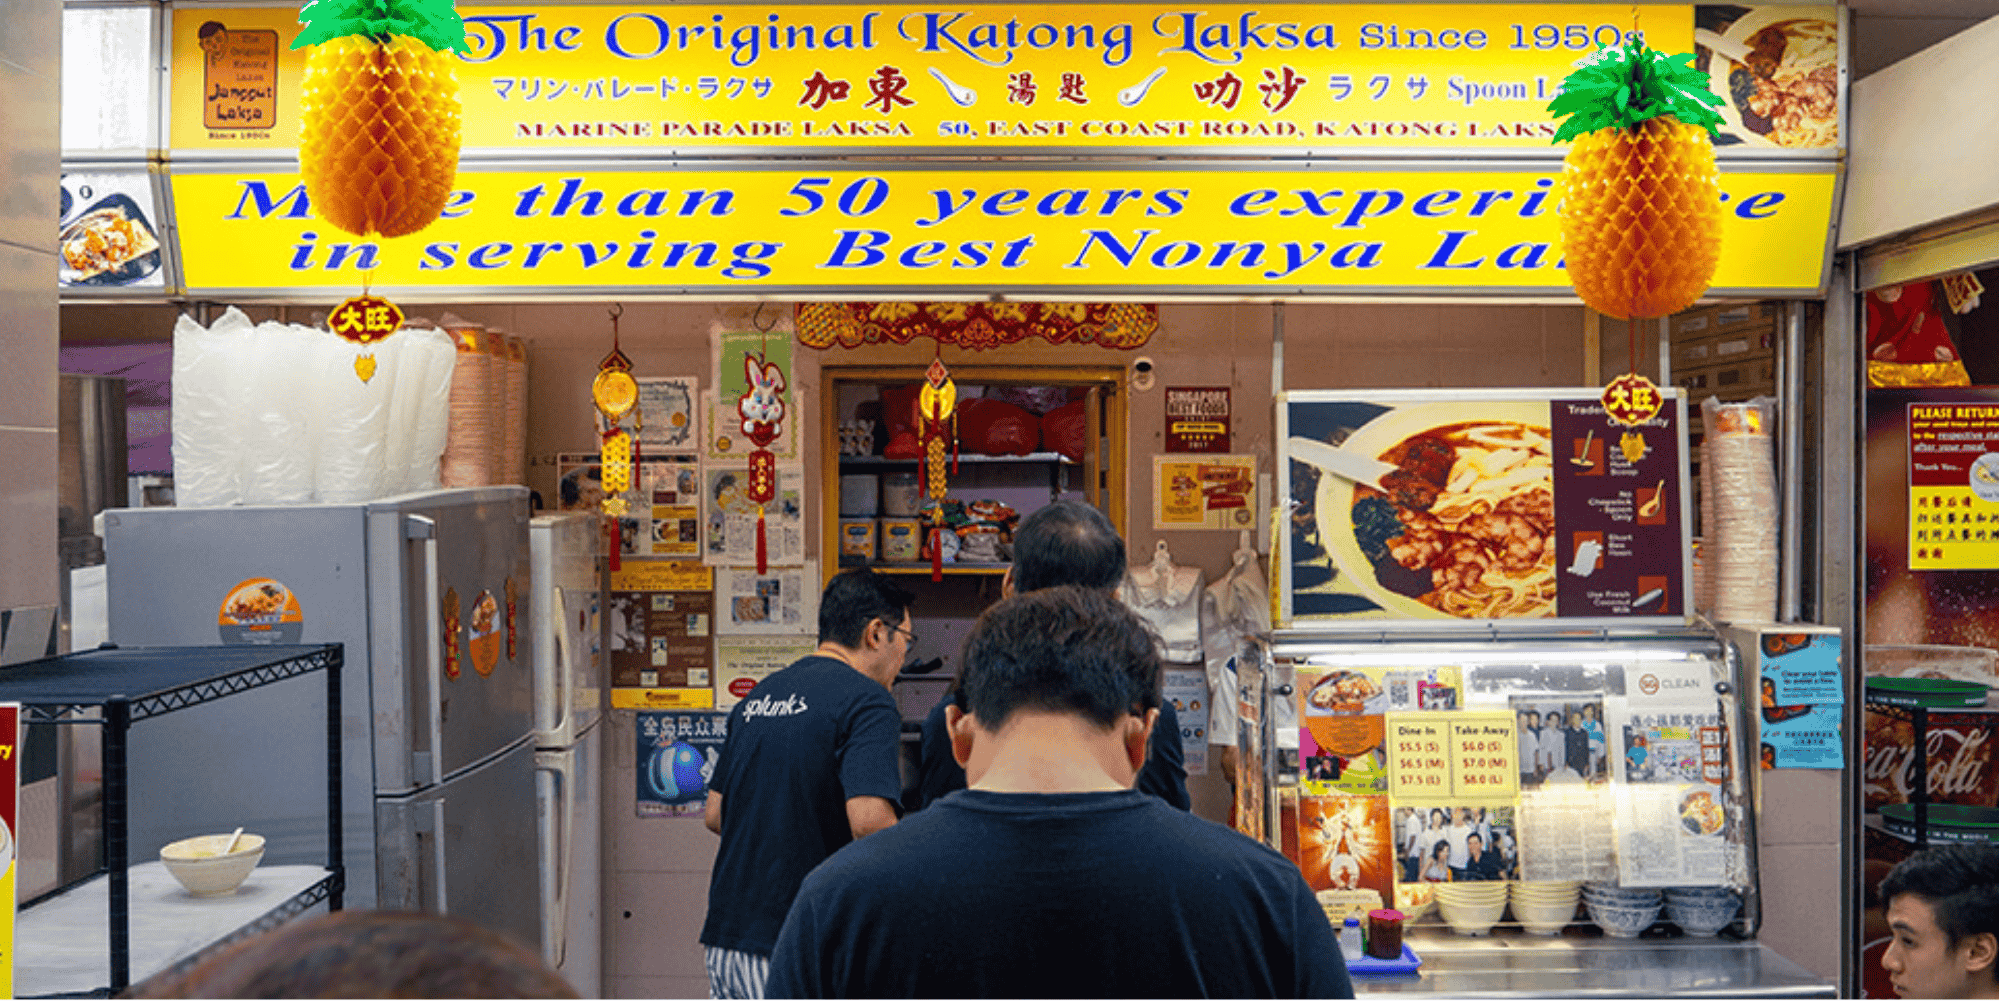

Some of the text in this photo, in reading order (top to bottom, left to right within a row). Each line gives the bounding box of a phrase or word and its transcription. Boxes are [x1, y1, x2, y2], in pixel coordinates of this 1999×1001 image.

[458, 11, 1646, 67] The Original Katong Laksa Since 1950s
[1447, 76, 1527, 106] Spoon
[514, 121, 914, 138] MARINE PARADE LAKSA
[937, 120, 1555, 140] 50, EAST COAST ROAD, KATONG LAKS
[222, 176, 1787, 230] Me than 50 years experie
[289, 231, 382, 271] in
[418, 229, 786, 280] serving
[814, 228, 1038, 270] Best
[1062, 228, 1387, 280] Nonya
[338, 305, 393, 333] 大旺
[1609, 385, 1655, 411] 大旺
[1913, 407, 1952, 419] PLEASE
[1661, 678, 1701, 689] CLEAN
